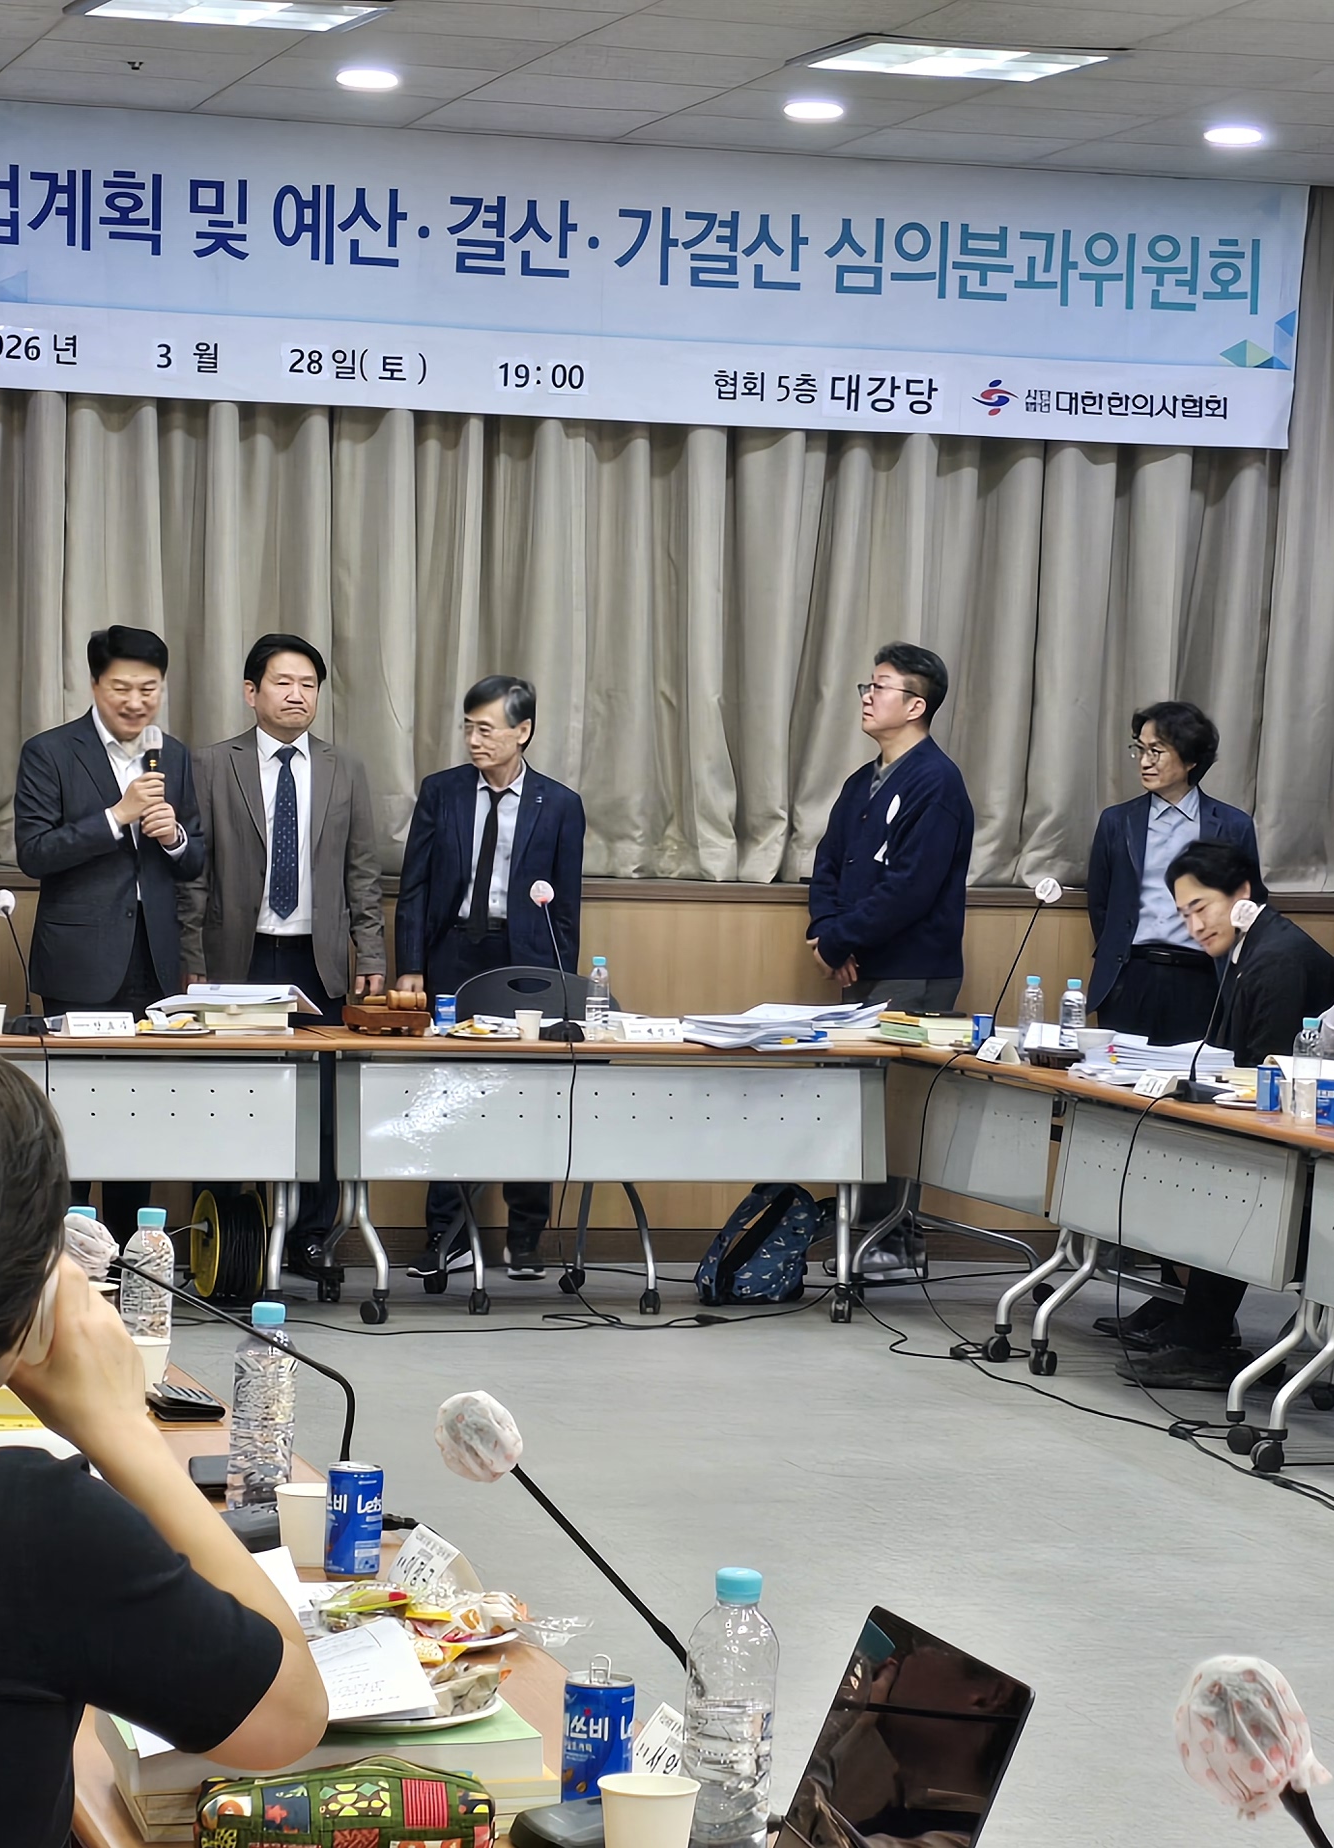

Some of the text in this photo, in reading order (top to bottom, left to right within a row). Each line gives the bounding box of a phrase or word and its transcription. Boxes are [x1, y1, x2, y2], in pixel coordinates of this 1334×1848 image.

[188, 179, 249, 261] 및
[825, 217, 1262, 315] 심의분과위원회
[52, 333, 79, 367] 년
[156, 343, 173, 369] 3
[193, 341, 220, 375] 월
[497, 362, 585, 391] 19:00
[714, 368, 766, 402] 협회
[776, 371, 818, 405] 5층
[829, 371, 939, 416] 대강당
[1056, 390, 1228, 419] 대한한의사협회
